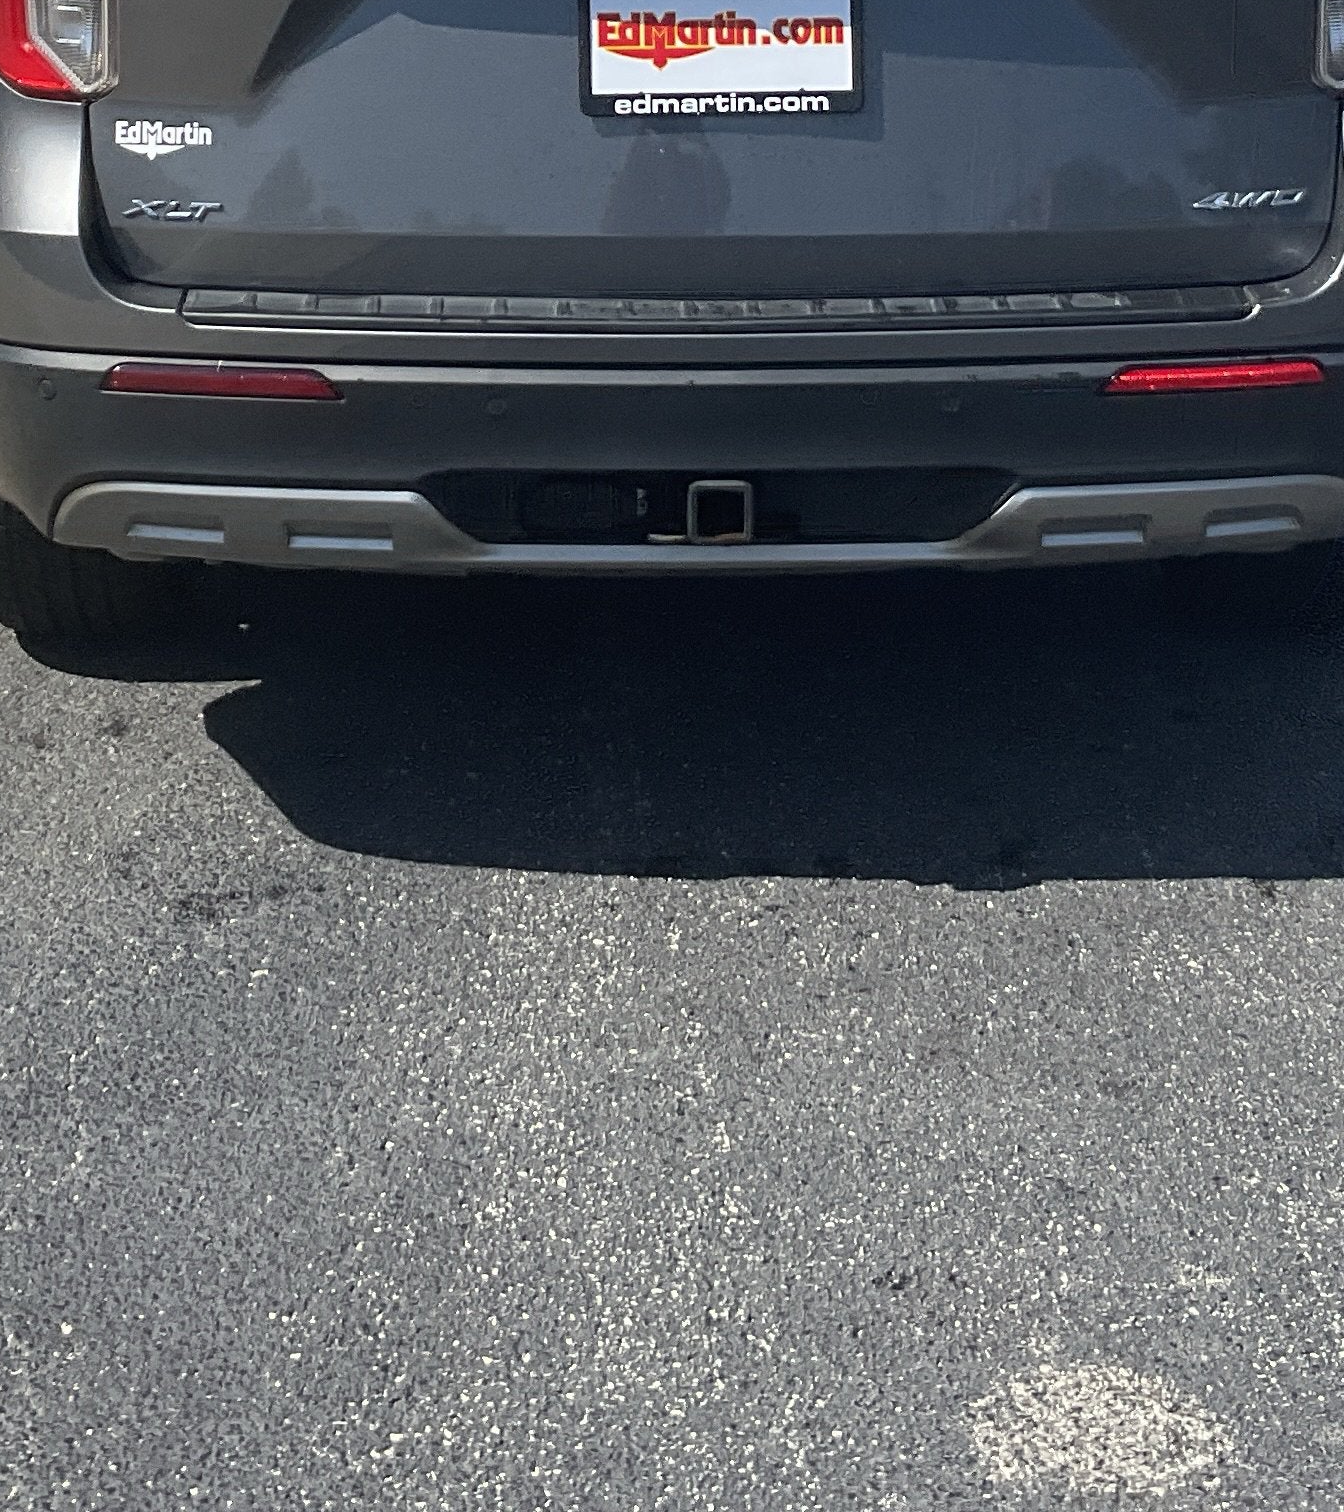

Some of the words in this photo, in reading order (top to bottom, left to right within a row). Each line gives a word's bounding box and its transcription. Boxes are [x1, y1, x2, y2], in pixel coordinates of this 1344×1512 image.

[614, 92, 830, 114] edmartin.com
[1192, 188, 1304, 209] 4WD
[121, 199, 224, 222] XLT
